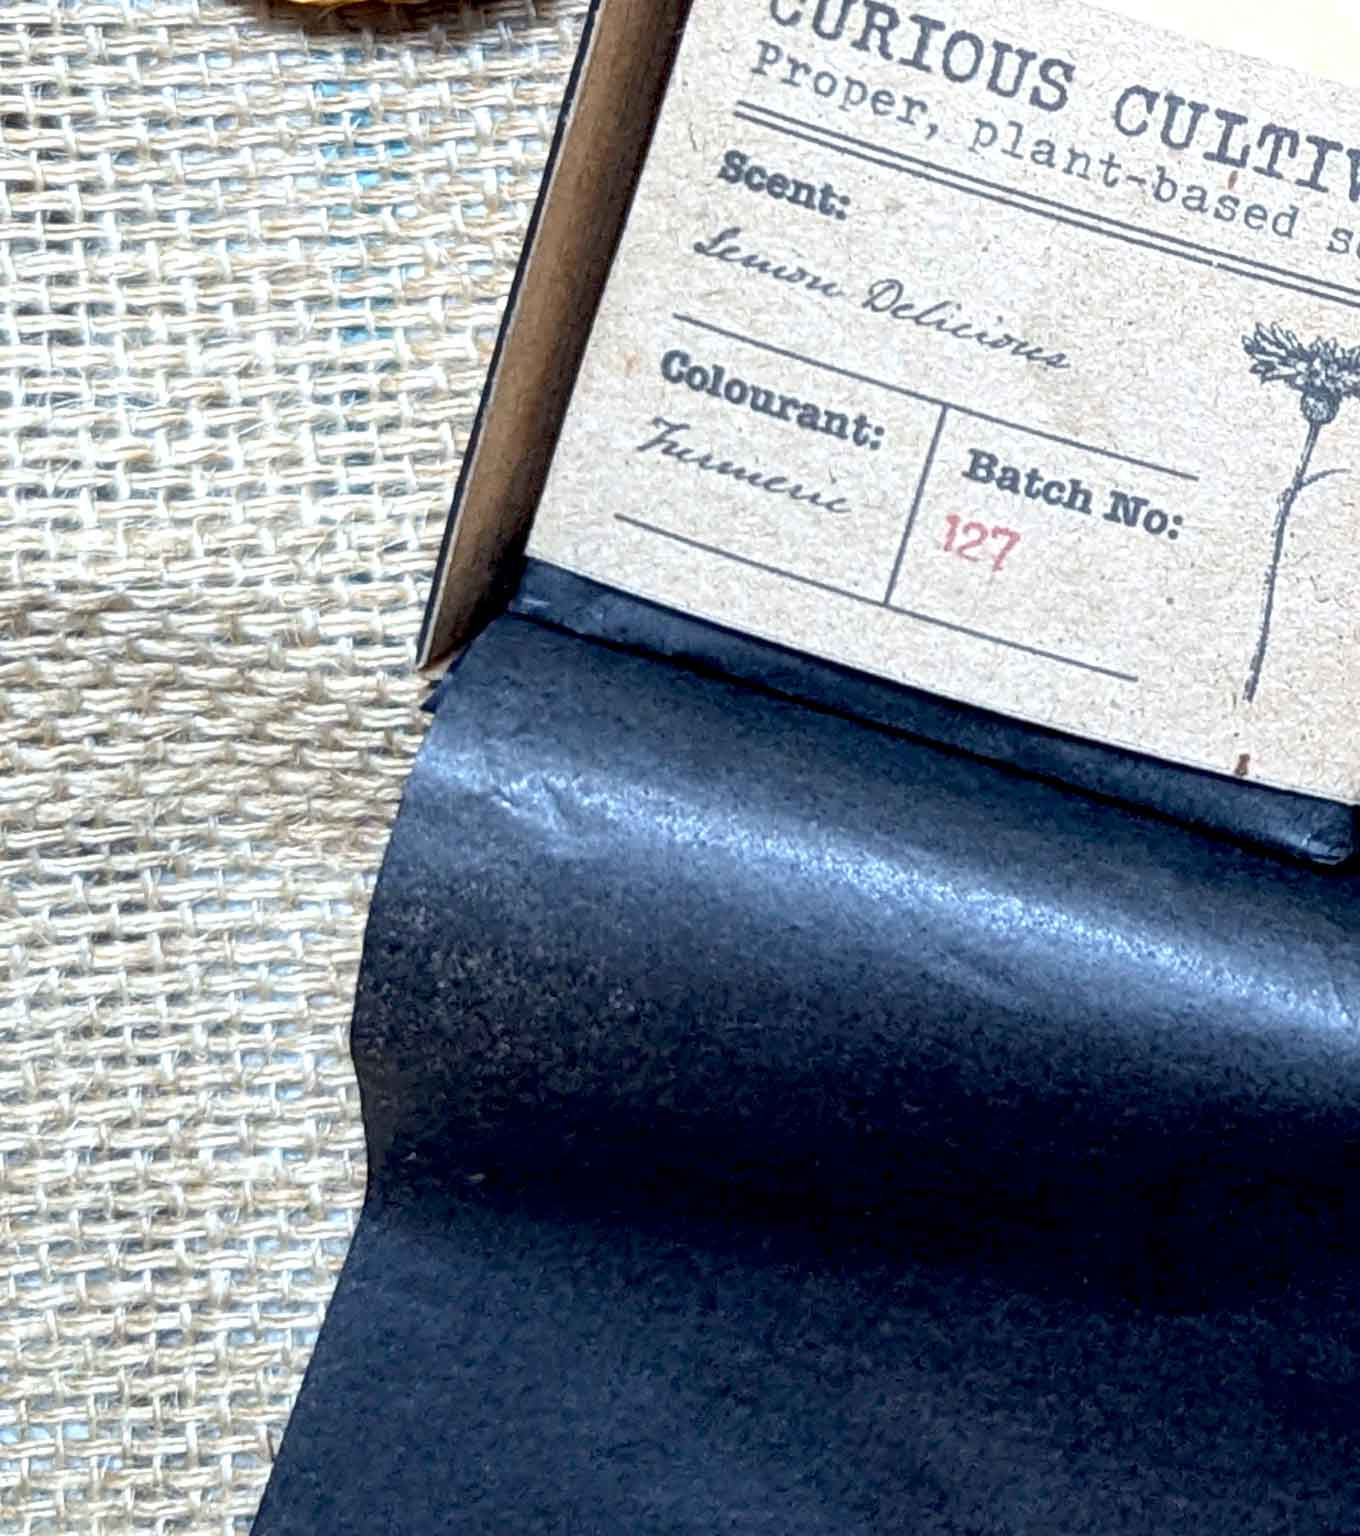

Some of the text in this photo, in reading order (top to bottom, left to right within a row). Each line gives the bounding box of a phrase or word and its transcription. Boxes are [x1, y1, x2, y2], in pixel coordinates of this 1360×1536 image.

[715, 148, 851, 221] Scent:
[749, 38, 939, 140] Proper,
[967, 116, 1300, 239] plant-based
[692, 225, 1070, 369] Lemon Delicious
[659, 348, 885, 451] Colourant:
[635, 415, 847, 513] Turmeric
[960, 447, 1184, 540] Batch No:
[942, 513, 1020, 571] 127
